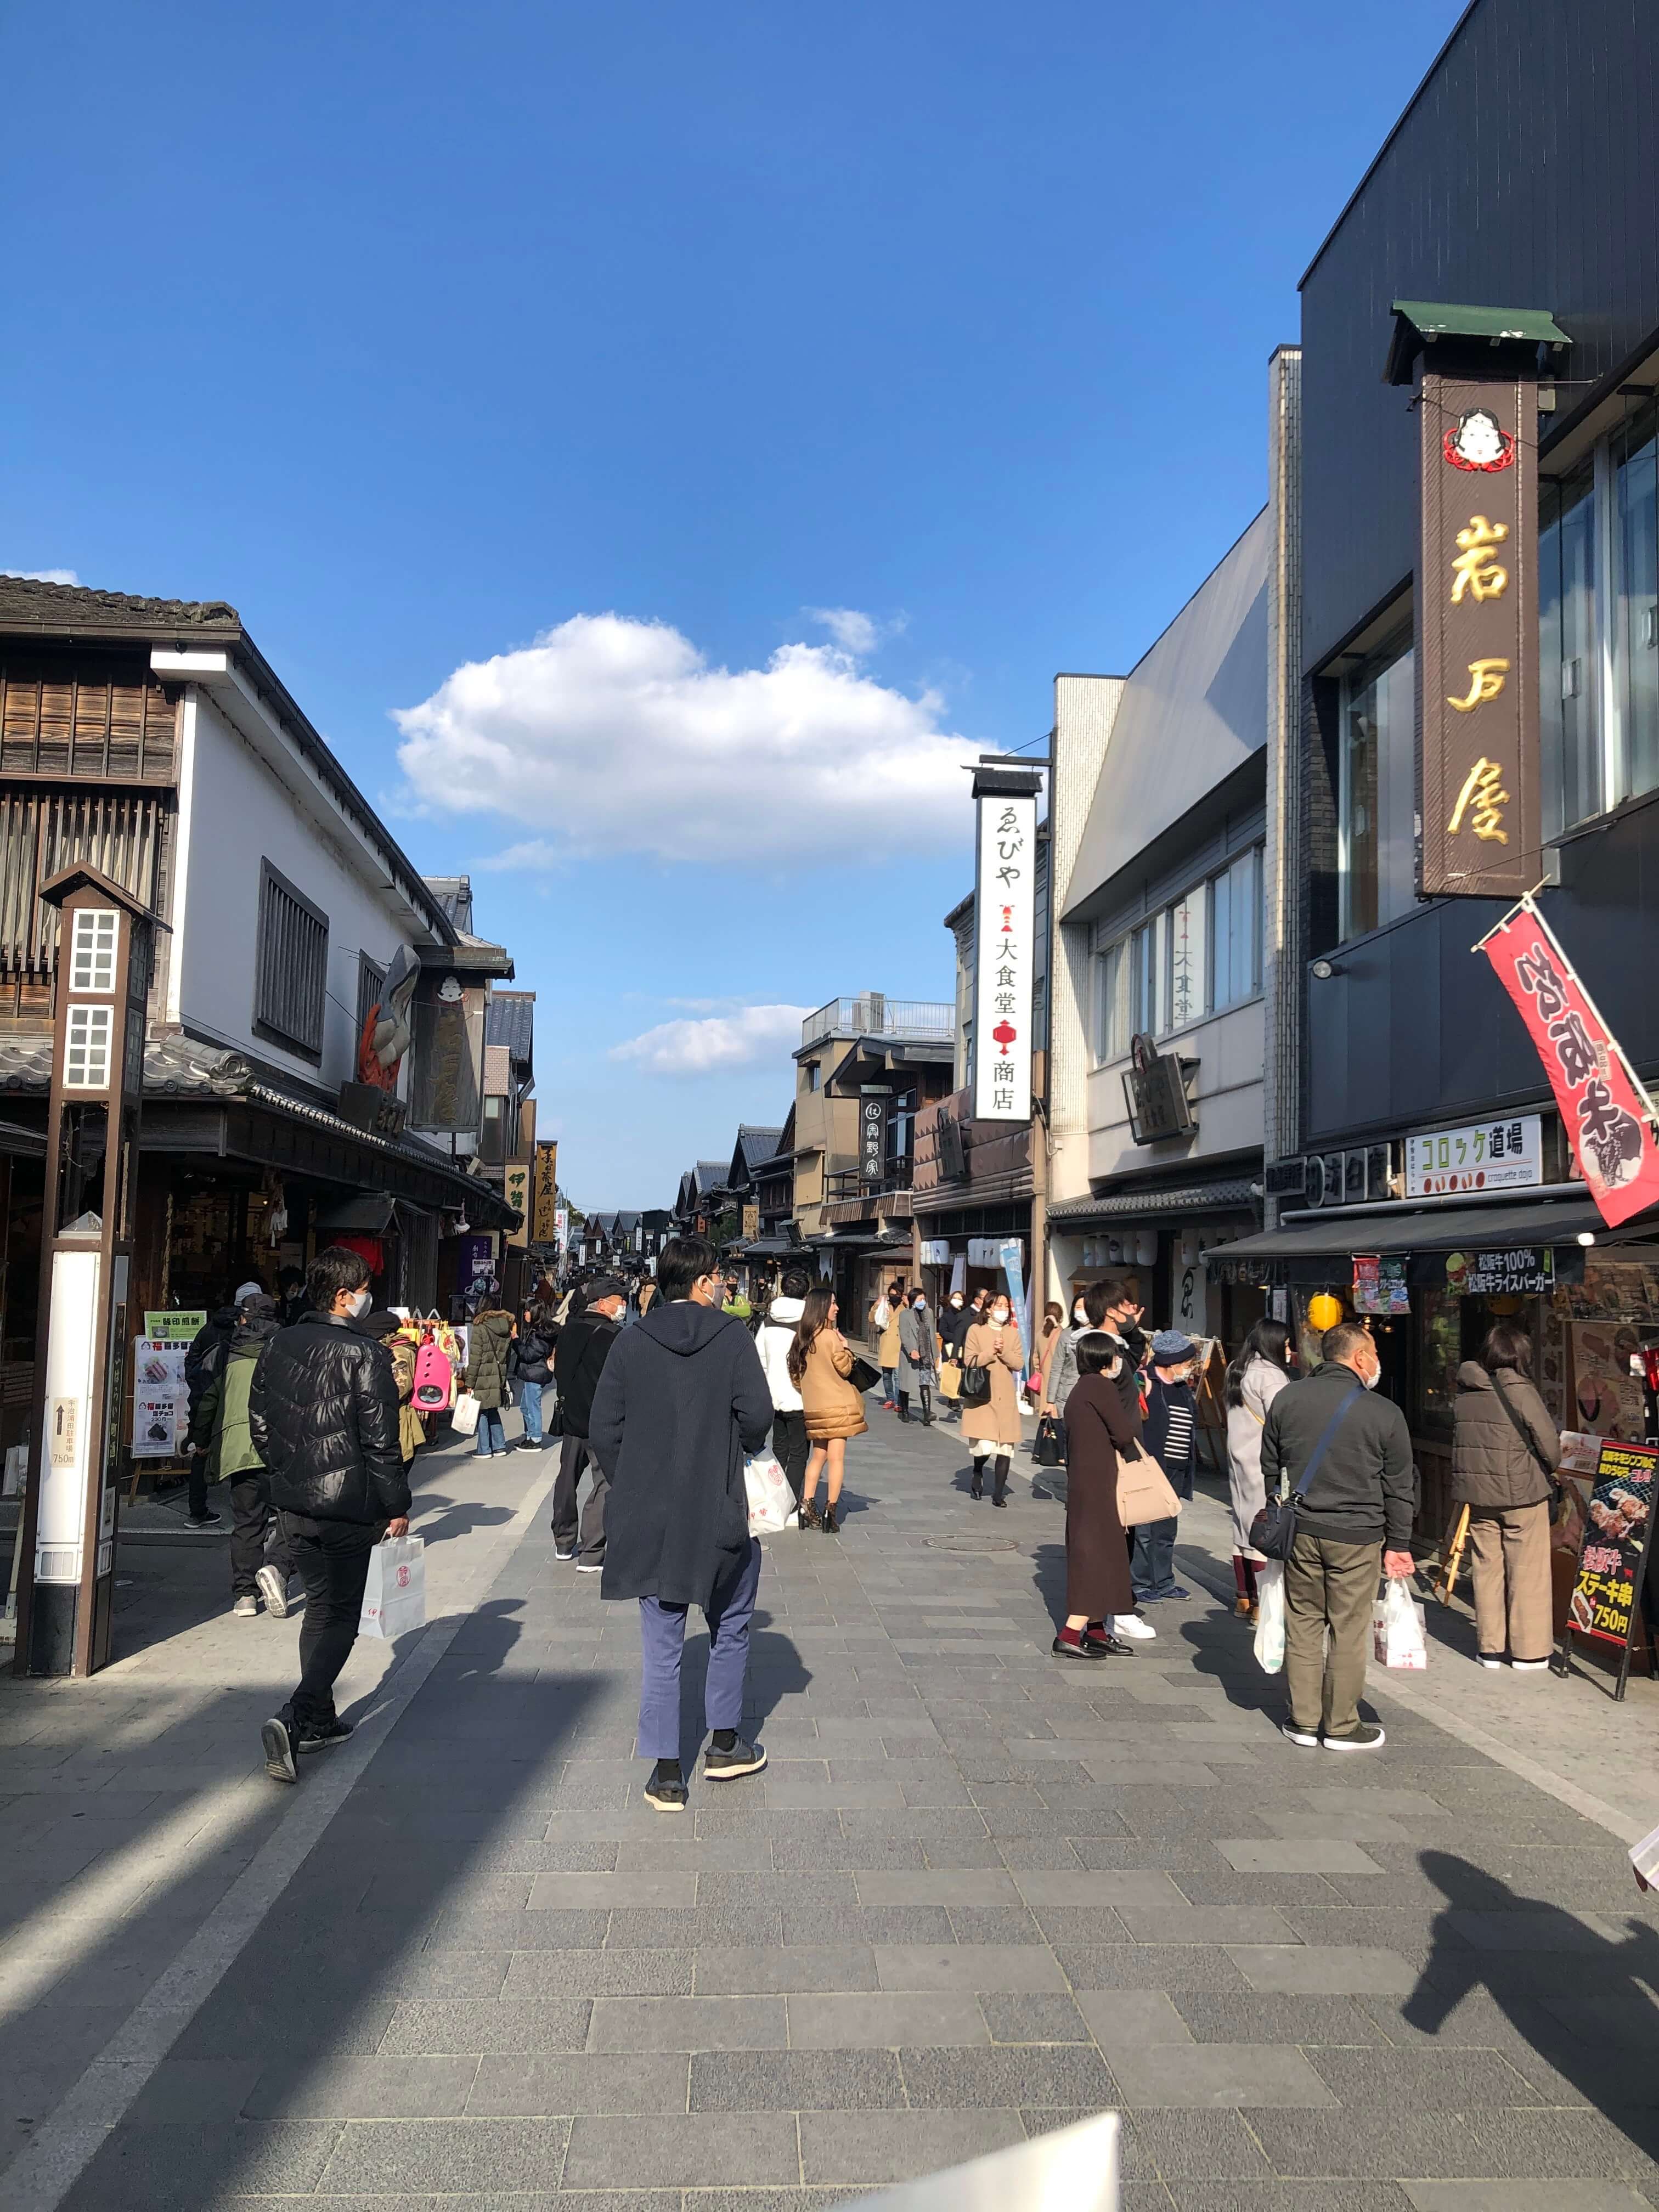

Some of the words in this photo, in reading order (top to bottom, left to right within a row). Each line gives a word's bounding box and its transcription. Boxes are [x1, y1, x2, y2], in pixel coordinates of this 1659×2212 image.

[1448, 516, 1510, 845] 岩戸屋
[996, 806, 1024, 889] ゑびや
[994, 938, 1018, 1014] 大食堂
[992, 1060, 1015, 1110] 商店
[1422, 1122, 1523, 1170] コロッケ道場
[1487, 1171, 1517, 1183] croquette
[1478, 1249, 1535, 1272] 松阪牛100%
[1468, 1272, 1553, 1293] 松阪牛ライスバーガー
[66, 1400, 75, 1452] 宇治浦田駐車場
[53, 1454, 74, 1463] 750m
[1576, 1570, 1633, 1607] ステーキ串
[1594, 1604, 1628, 1634] 750円
